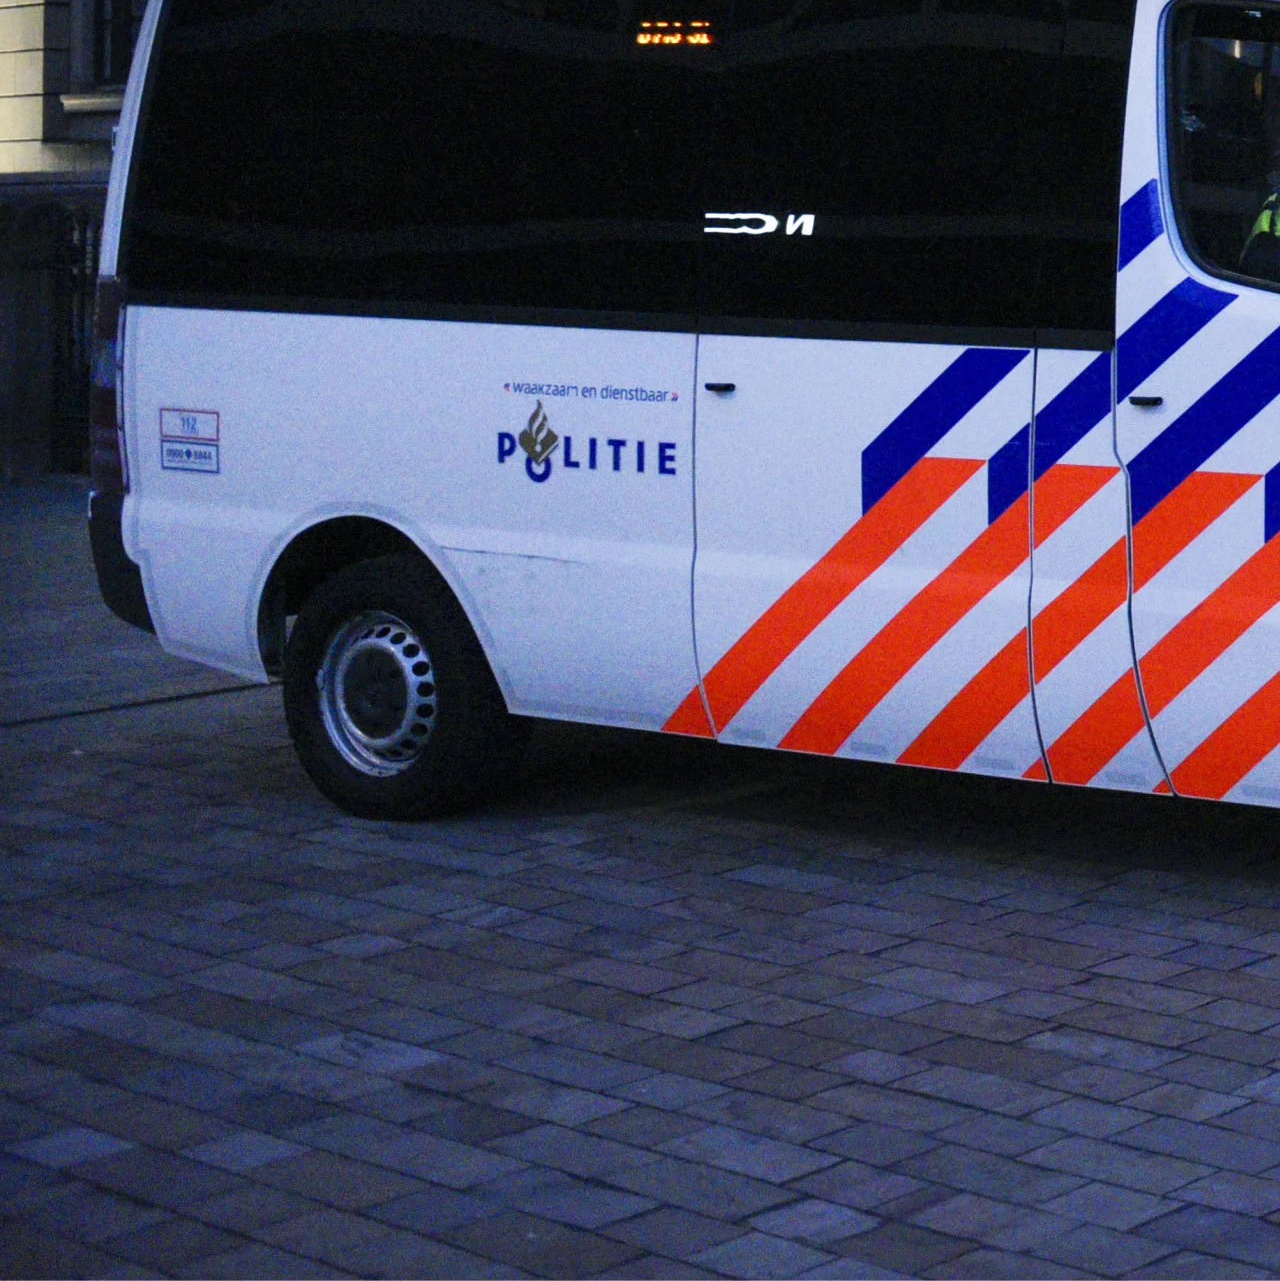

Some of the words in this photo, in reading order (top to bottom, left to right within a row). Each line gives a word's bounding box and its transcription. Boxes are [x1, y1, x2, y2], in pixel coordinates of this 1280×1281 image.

[581, 387, 597, 398] en
[600, 385, 669, 402] dienstbaar
[181, 416, 197, 430] 112
[498, 431, 677, 483] POLITIE
